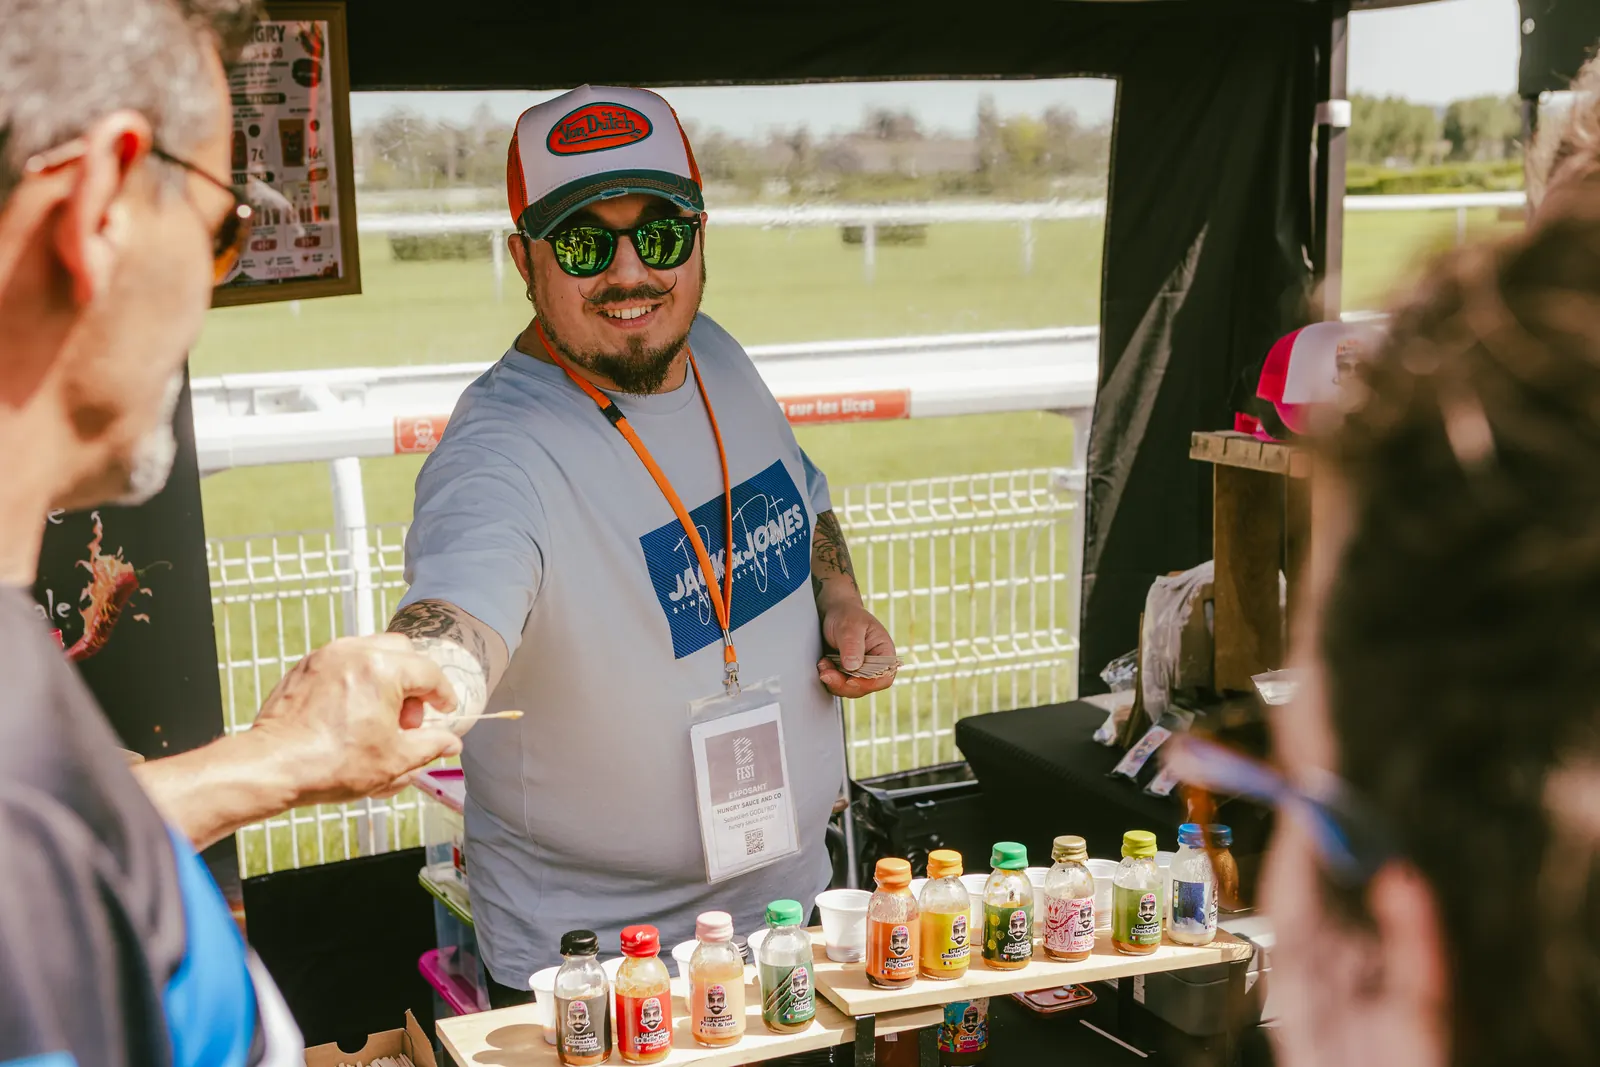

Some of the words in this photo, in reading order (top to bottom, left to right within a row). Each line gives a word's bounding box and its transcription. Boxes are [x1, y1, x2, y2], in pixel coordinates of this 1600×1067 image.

[253, 25, 286, 43] GRY
[557, 116, 588, 142] Von
[585, 110, 635, 134] Dutch
[736, 764, 755, 781] FEST
[728, 782, 768, 801] EXPOSANT
[717, 803, 741, 815] HUNGRY
[741, 798, 760, 809] SAUCE
[760, 795, 773, 803] AND
[773, 792, 782, 800] CO
